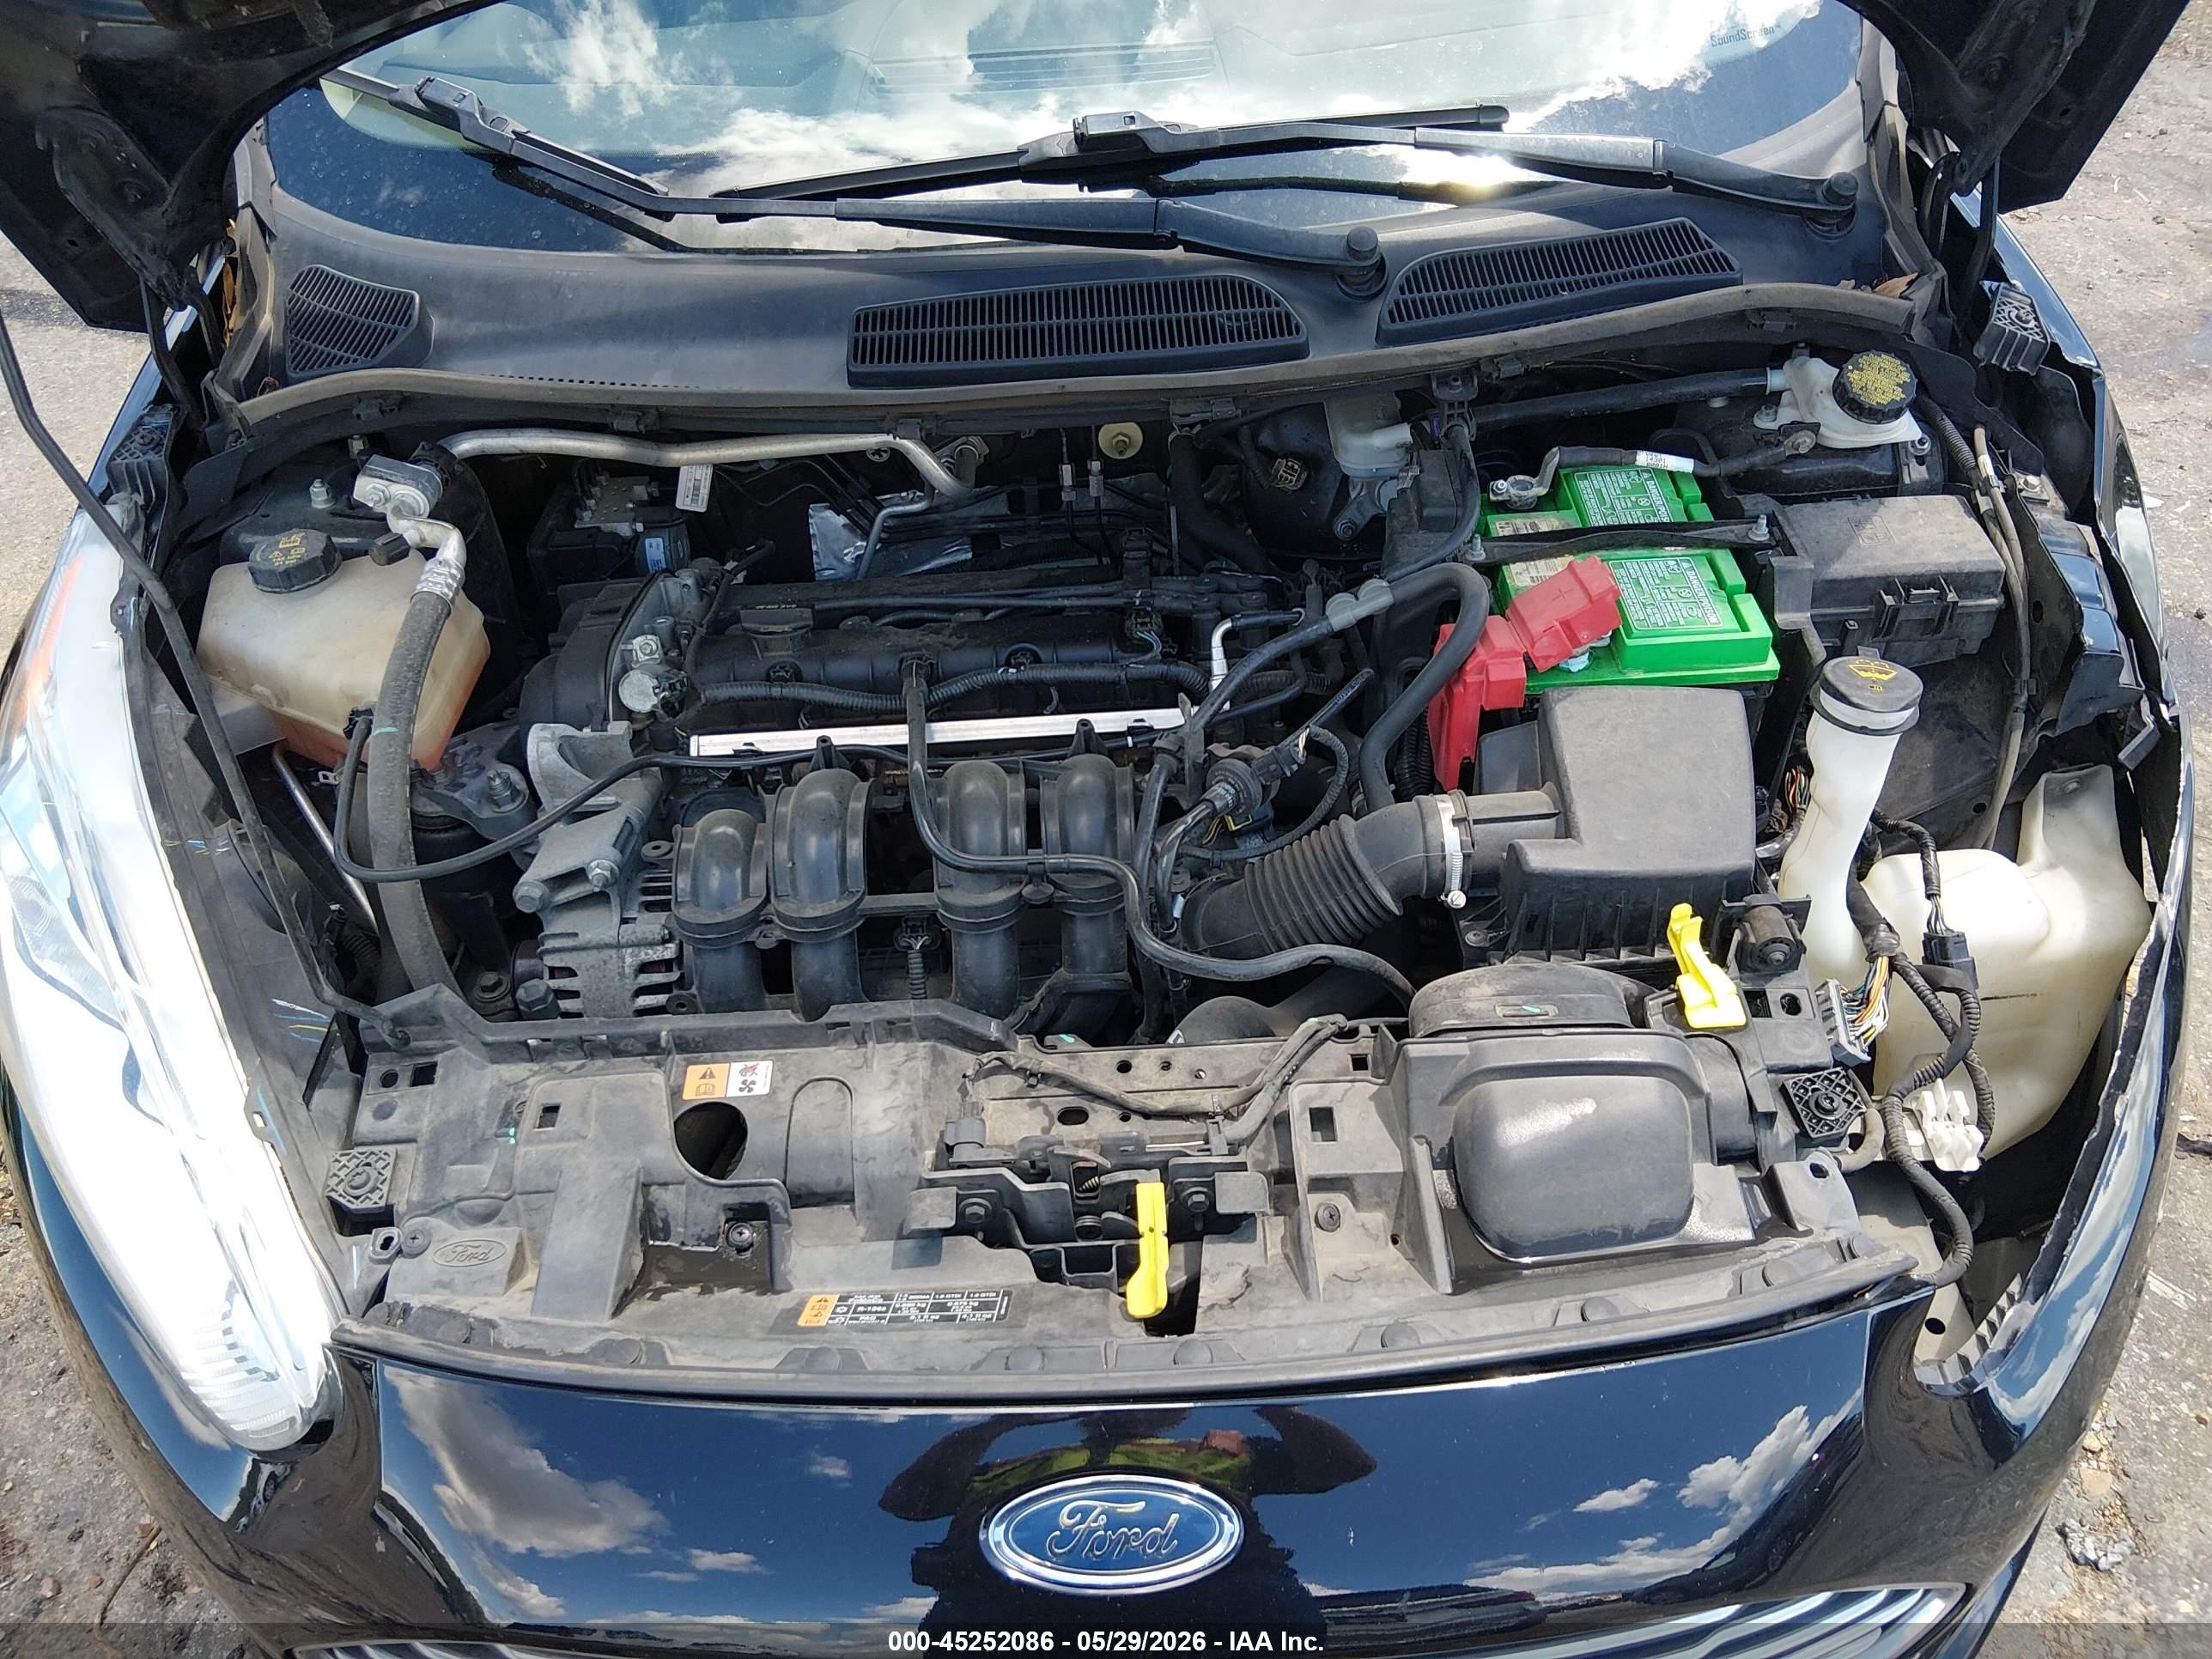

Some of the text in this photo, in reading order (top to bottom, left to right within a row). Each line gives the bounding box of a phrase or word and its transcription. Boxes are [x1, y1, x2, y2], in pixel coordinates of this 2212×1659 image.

[1710, 25, 1775, 47] SoundScreen
[1646, 480, 1670, 522] DANGER/POIS
[1686, 570, 1718, 623] DANGER/POISON
[444, 1244, 494, 1263] Ford
[1046, 1501, 1180, 1559] Ford
